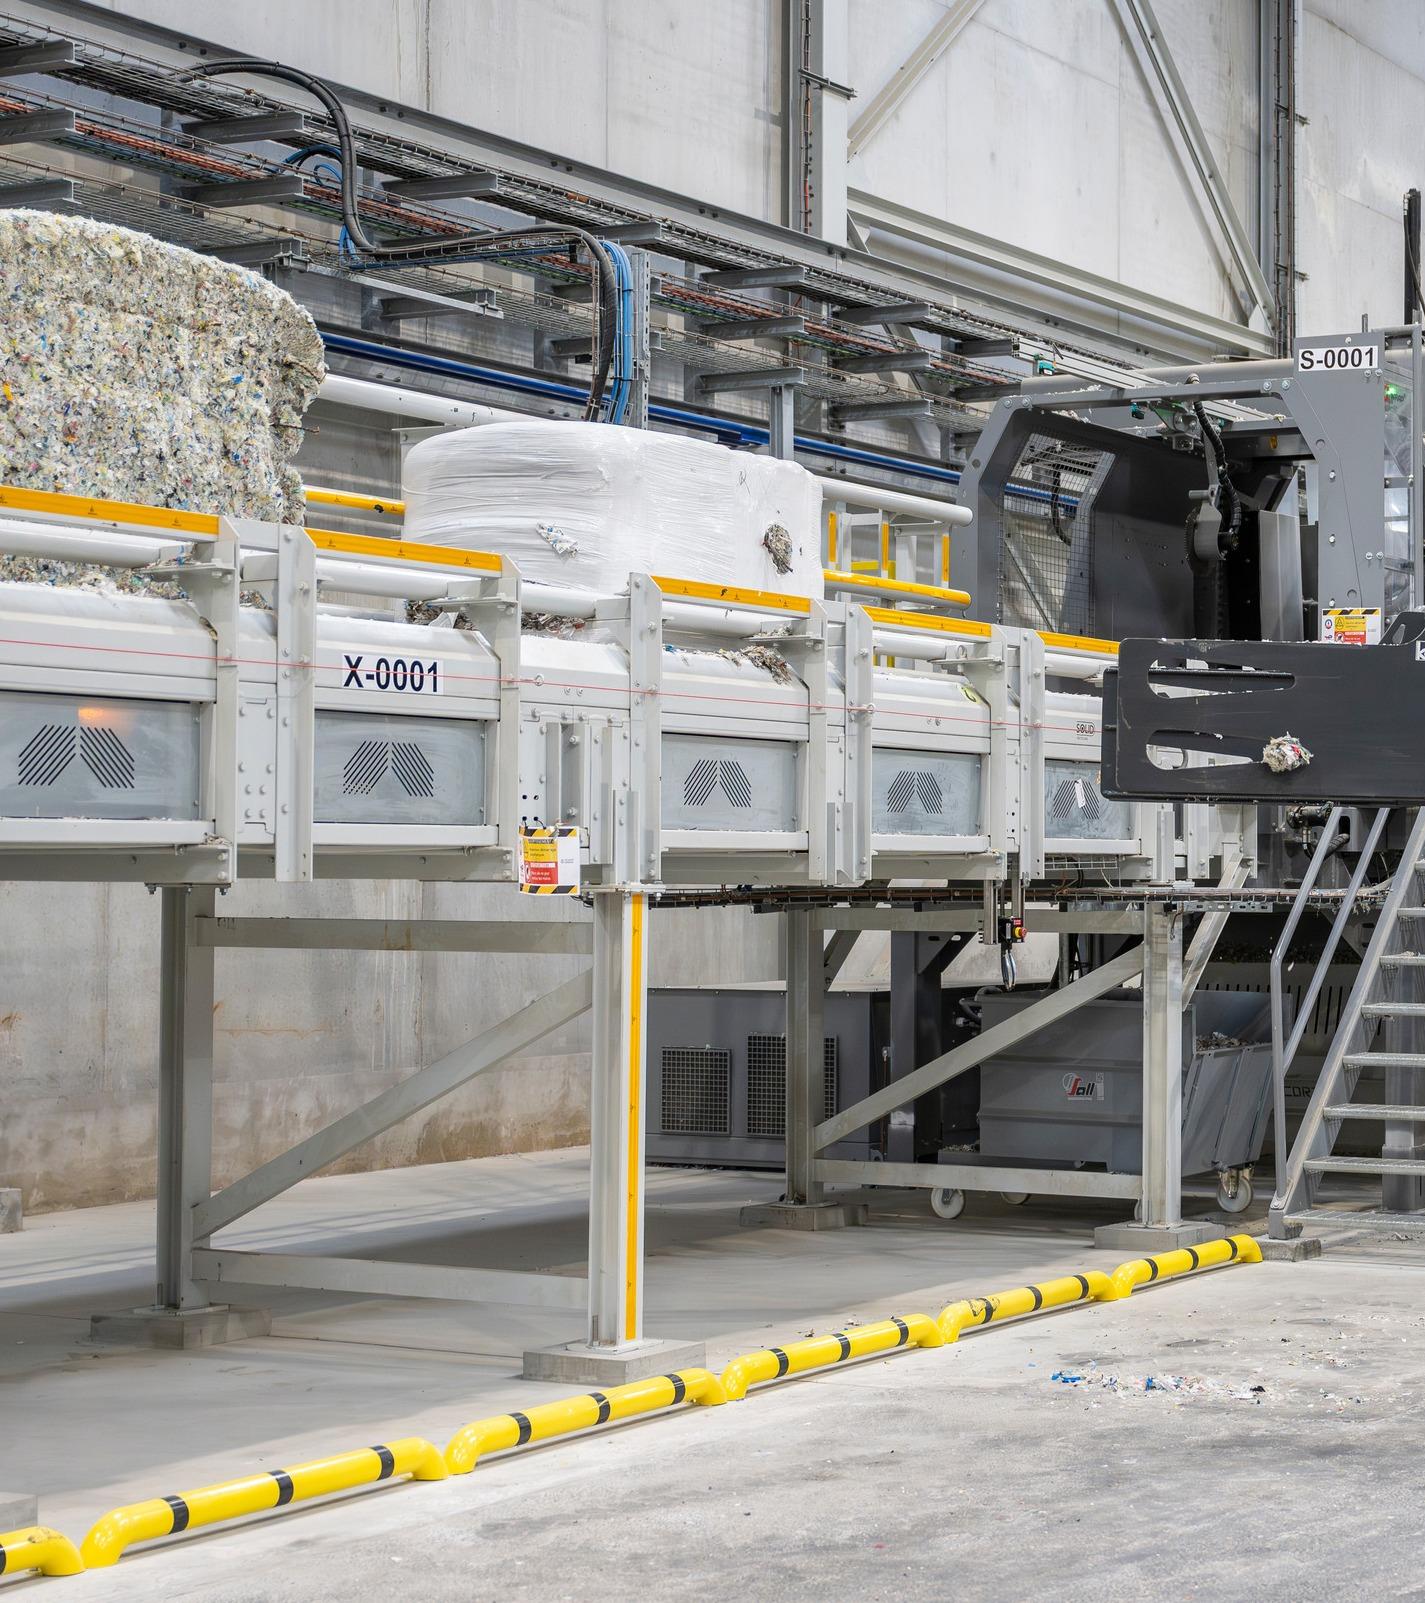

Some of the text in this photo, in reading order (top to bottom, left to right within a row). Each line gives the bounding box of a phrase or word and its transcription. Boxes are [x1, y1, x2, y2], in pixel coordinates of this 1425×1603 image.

[1300, 347, 1374, 370] S-0001
[343, 655, 438, 693] X-0001
[1076, 723, 1095, 735] SOLID
